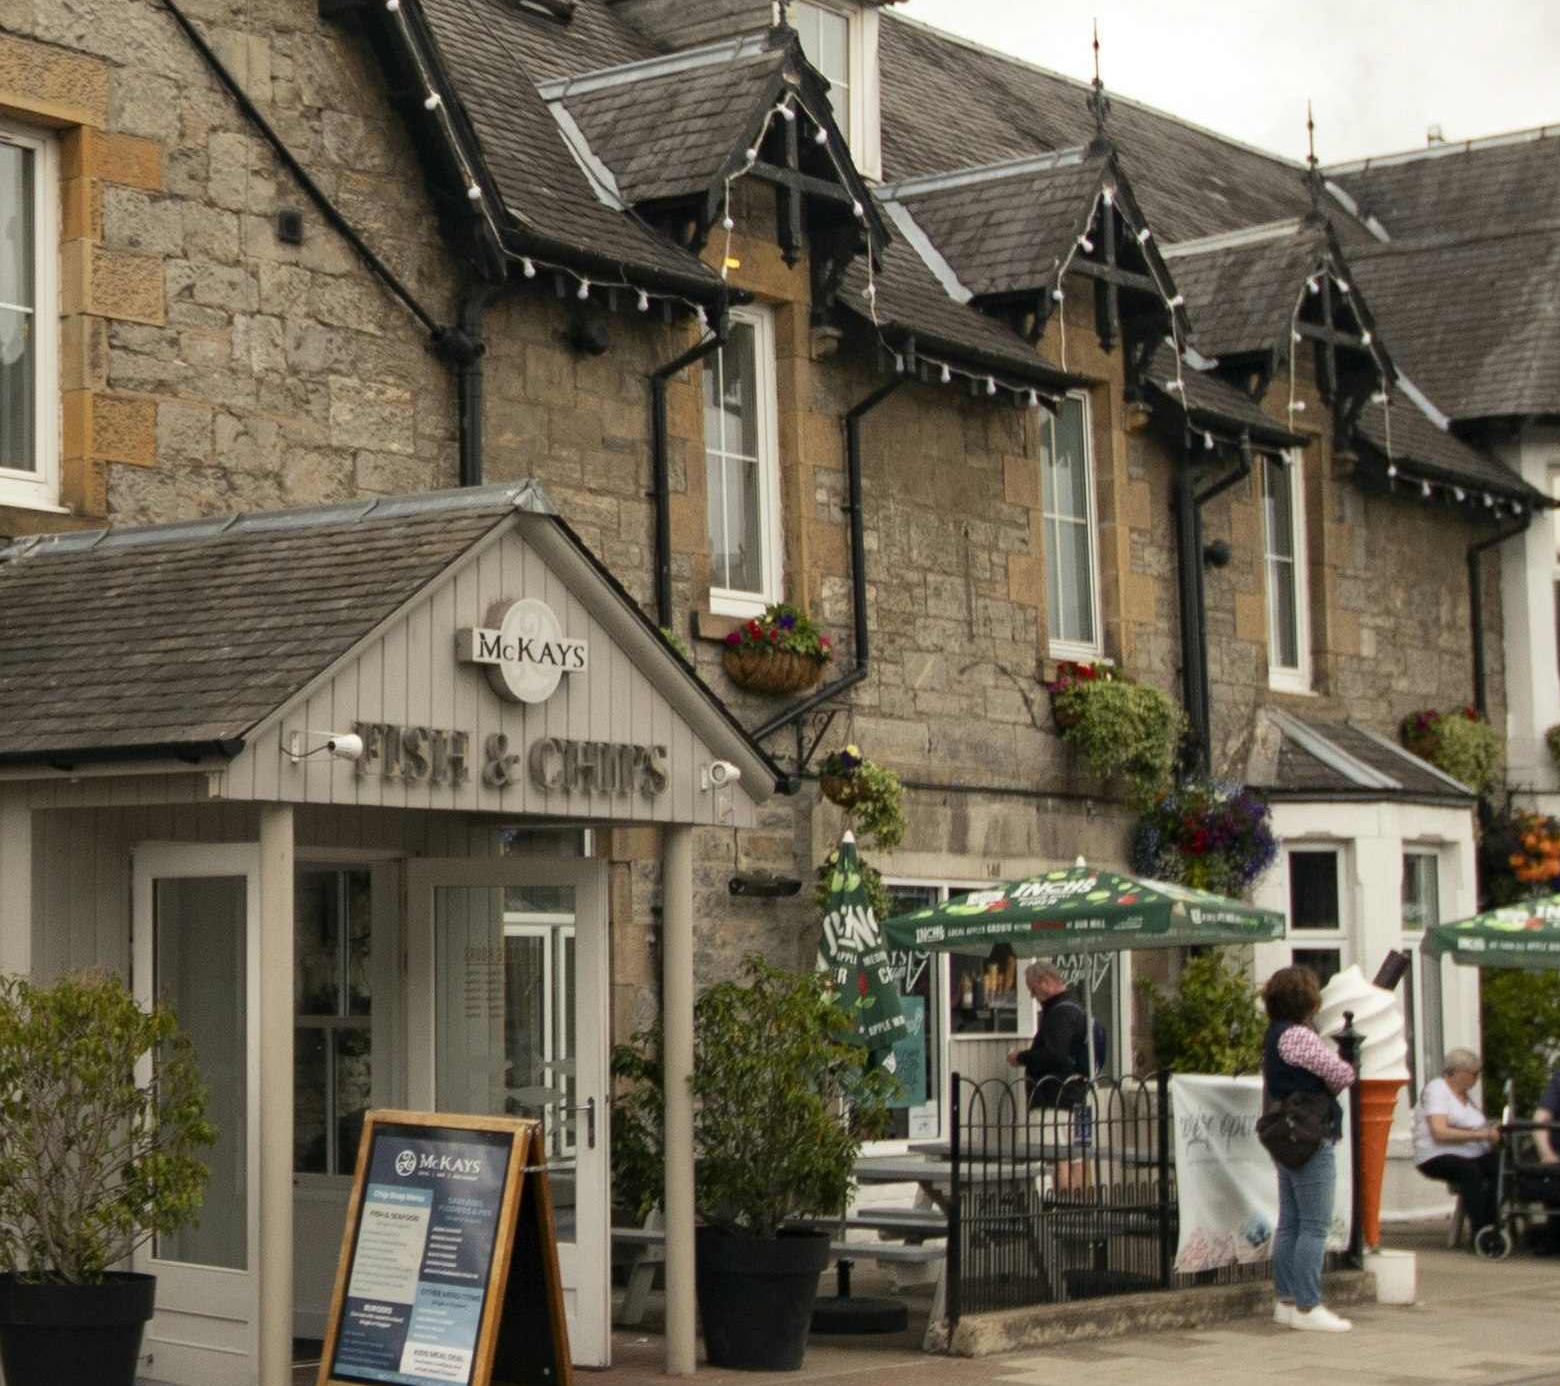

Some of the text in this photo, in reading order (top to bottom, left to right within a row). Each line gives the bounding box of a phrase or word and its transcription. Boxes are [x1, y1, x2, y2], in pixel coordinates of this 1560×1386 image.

[477, 631, 585, 670] McKAYS
[355, 721, 668, 798] FISH & CHIPS
[419, 1153, 482, 1174] McKAYS
